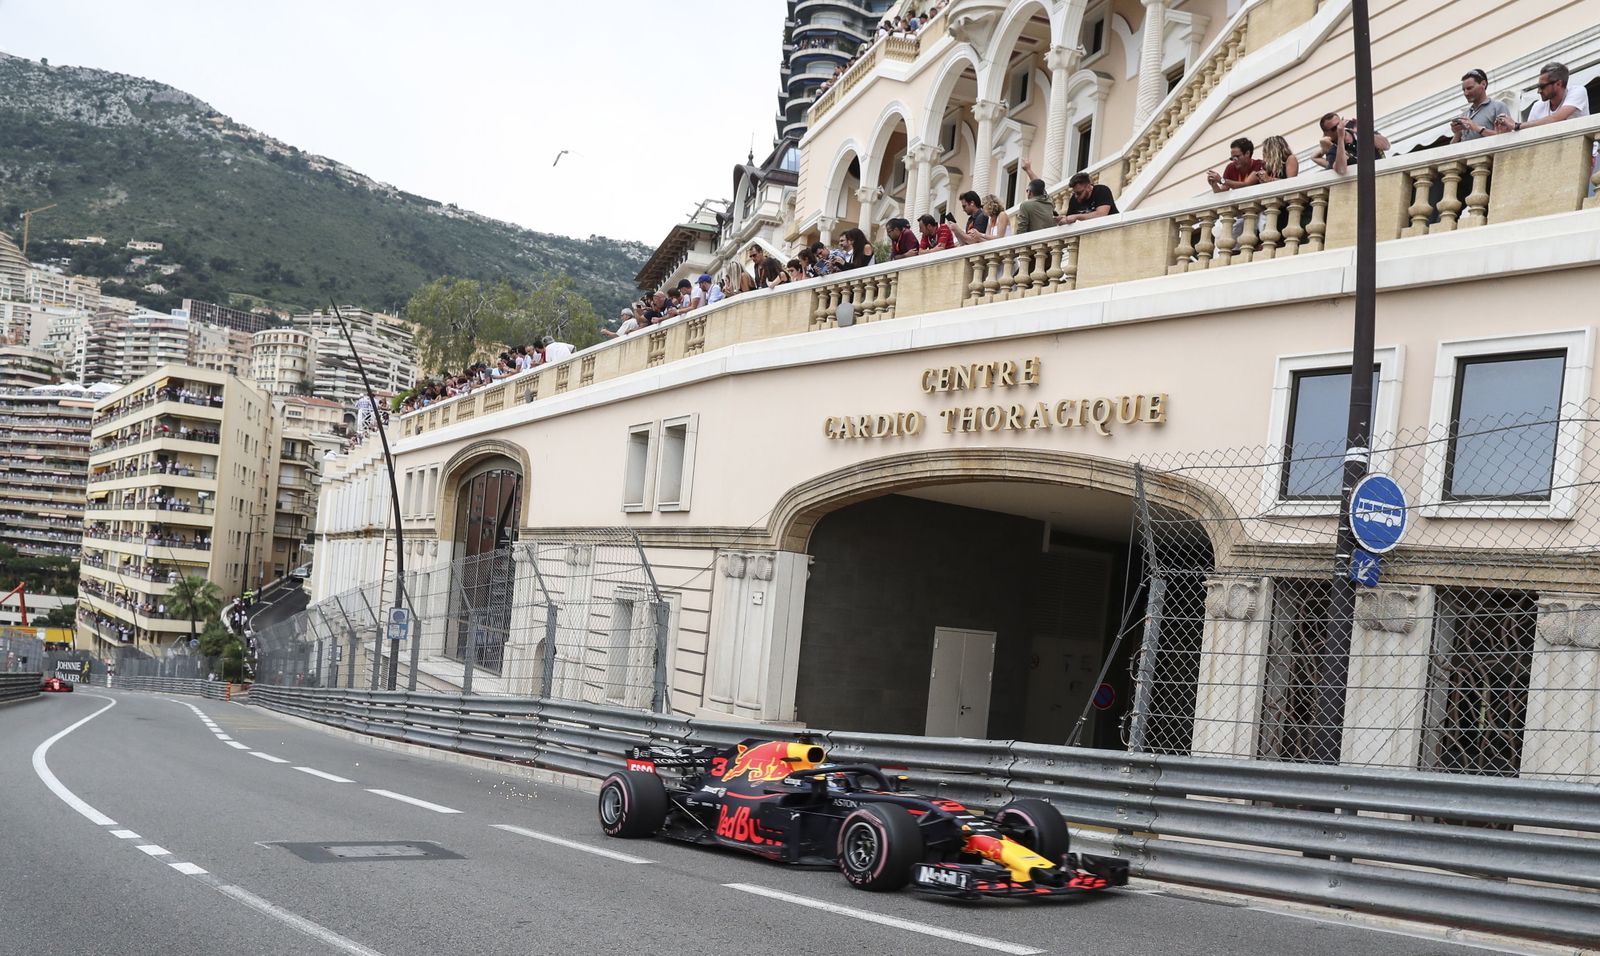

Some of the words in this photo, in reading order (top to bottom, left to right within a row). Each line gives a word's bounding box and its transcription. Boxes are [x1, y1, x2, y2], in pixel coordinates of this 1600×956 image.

[920, 356, 1041, 394] CENTRE
[823, 410, 925, 440] CARDIO
[940, 393, 1169, 436] THORACIQUE
[56, 660, 81, 671] JOHNNIE
[55, 672, 80, 682] WALKER
[711, 757, 728, 777] 3
[918, 866, 957, 885] Mobil
